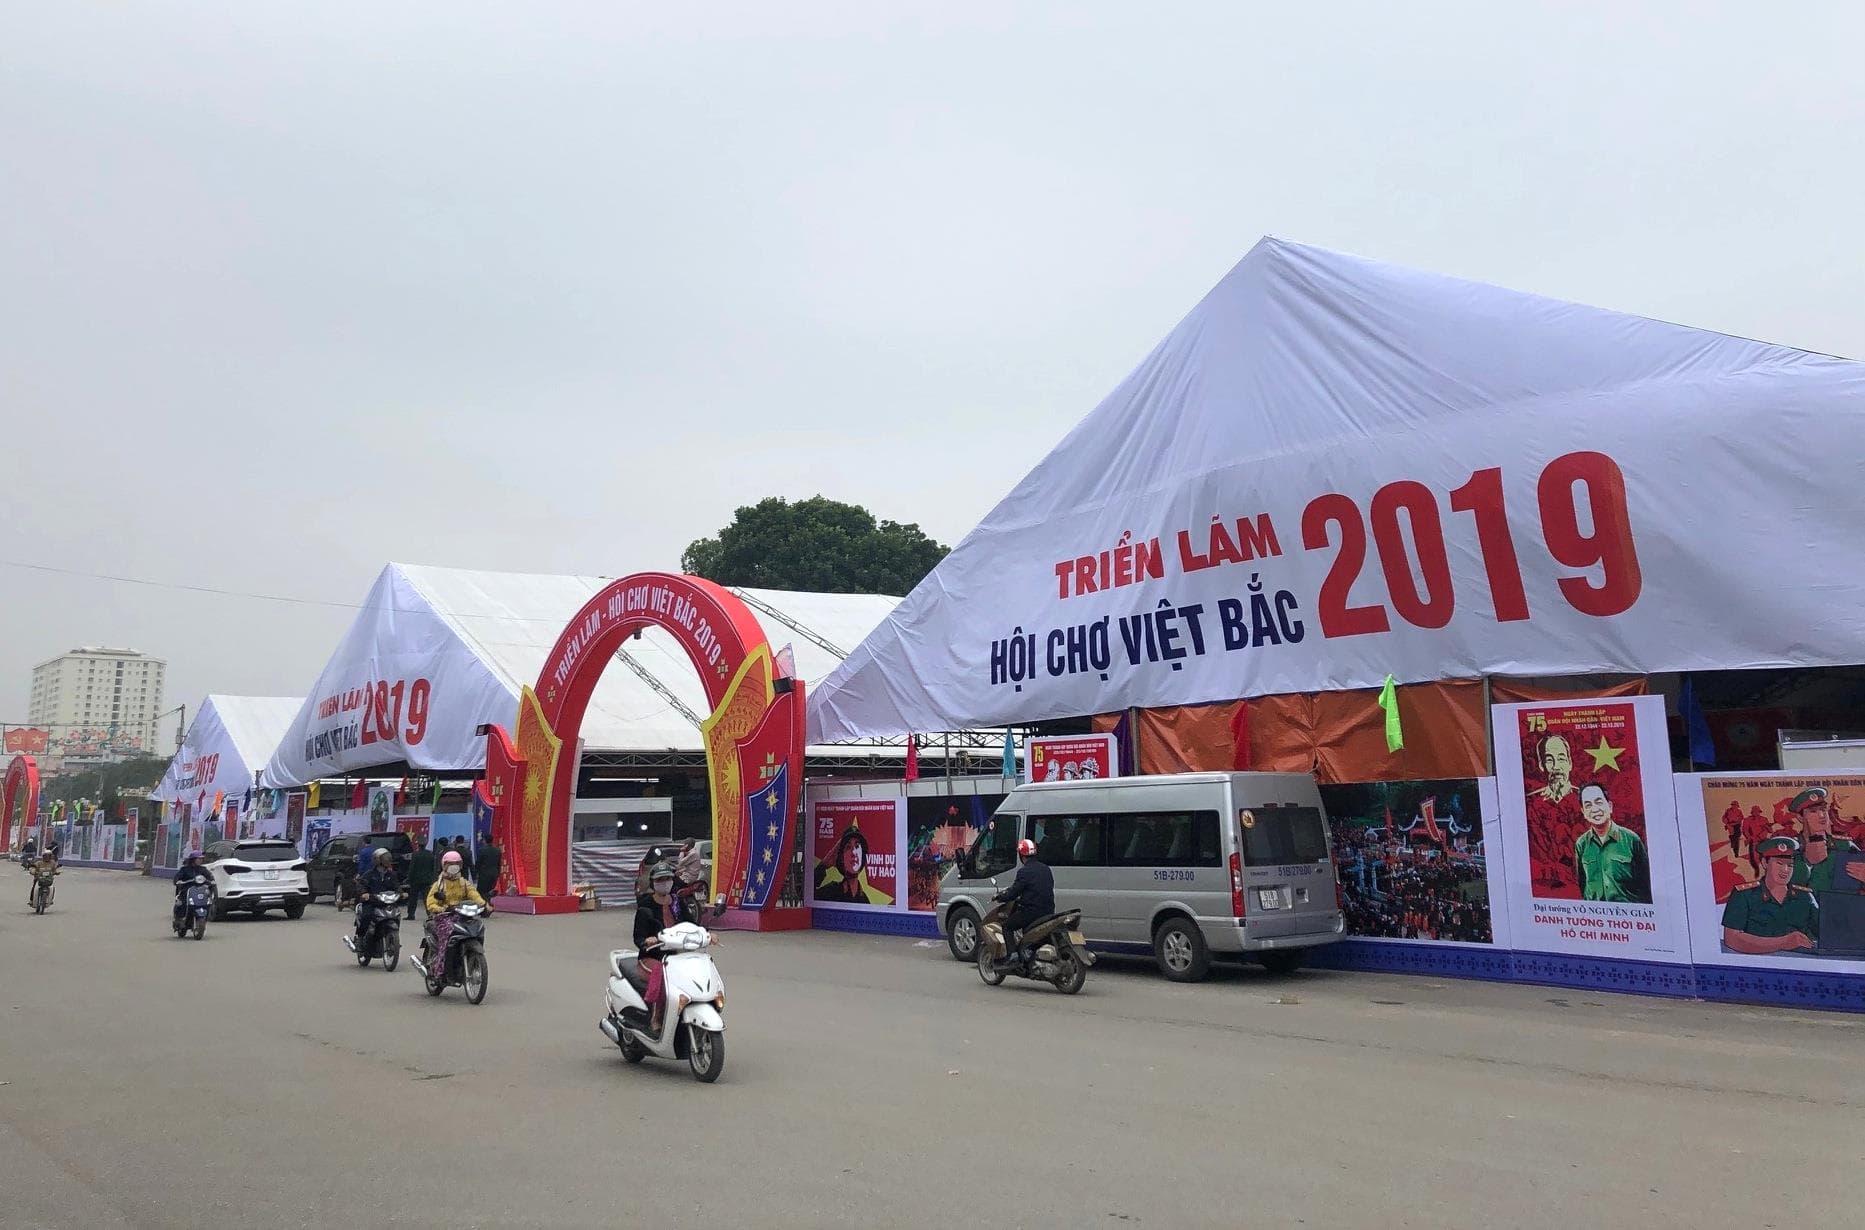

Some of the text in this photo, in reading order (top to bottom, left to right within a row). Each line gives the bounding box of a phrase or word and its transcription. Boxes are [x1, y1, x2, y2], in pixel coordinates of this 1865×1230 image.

[1301, 451, 1642, 638] 2019
[1055, 513, 1282, 599] TRIỂN LÃM
[555, 637, 580, 686] TRIỂN
[580, 609, 600, 646] LÃM
[609, 589, 625, 621] HỘI
[628, 584, 649, 615] CHỢ
[651, 585, 675, 618] VIỆT
[674, 593, 697, 631] BẮC
[694, 618, 721, 666] 2019
[991, 573, 1305, 692] HỘI CHỢ VIỆT BẮC
[361, 679, 431, 746] 2019
[1527, 716, 1547, 732] 75
[1033, 746, 1044, 762] 75
[819, 818, 834, 829] 75
[866, 854, 883, 865] VINH
[867, 865, 896, 879] TỰ HÀO
[1534, 915, 1564, 925] DANH
[1636, 922, 1656, 933] ĐẠI
[1600, 931, 1630, 942] MINH
